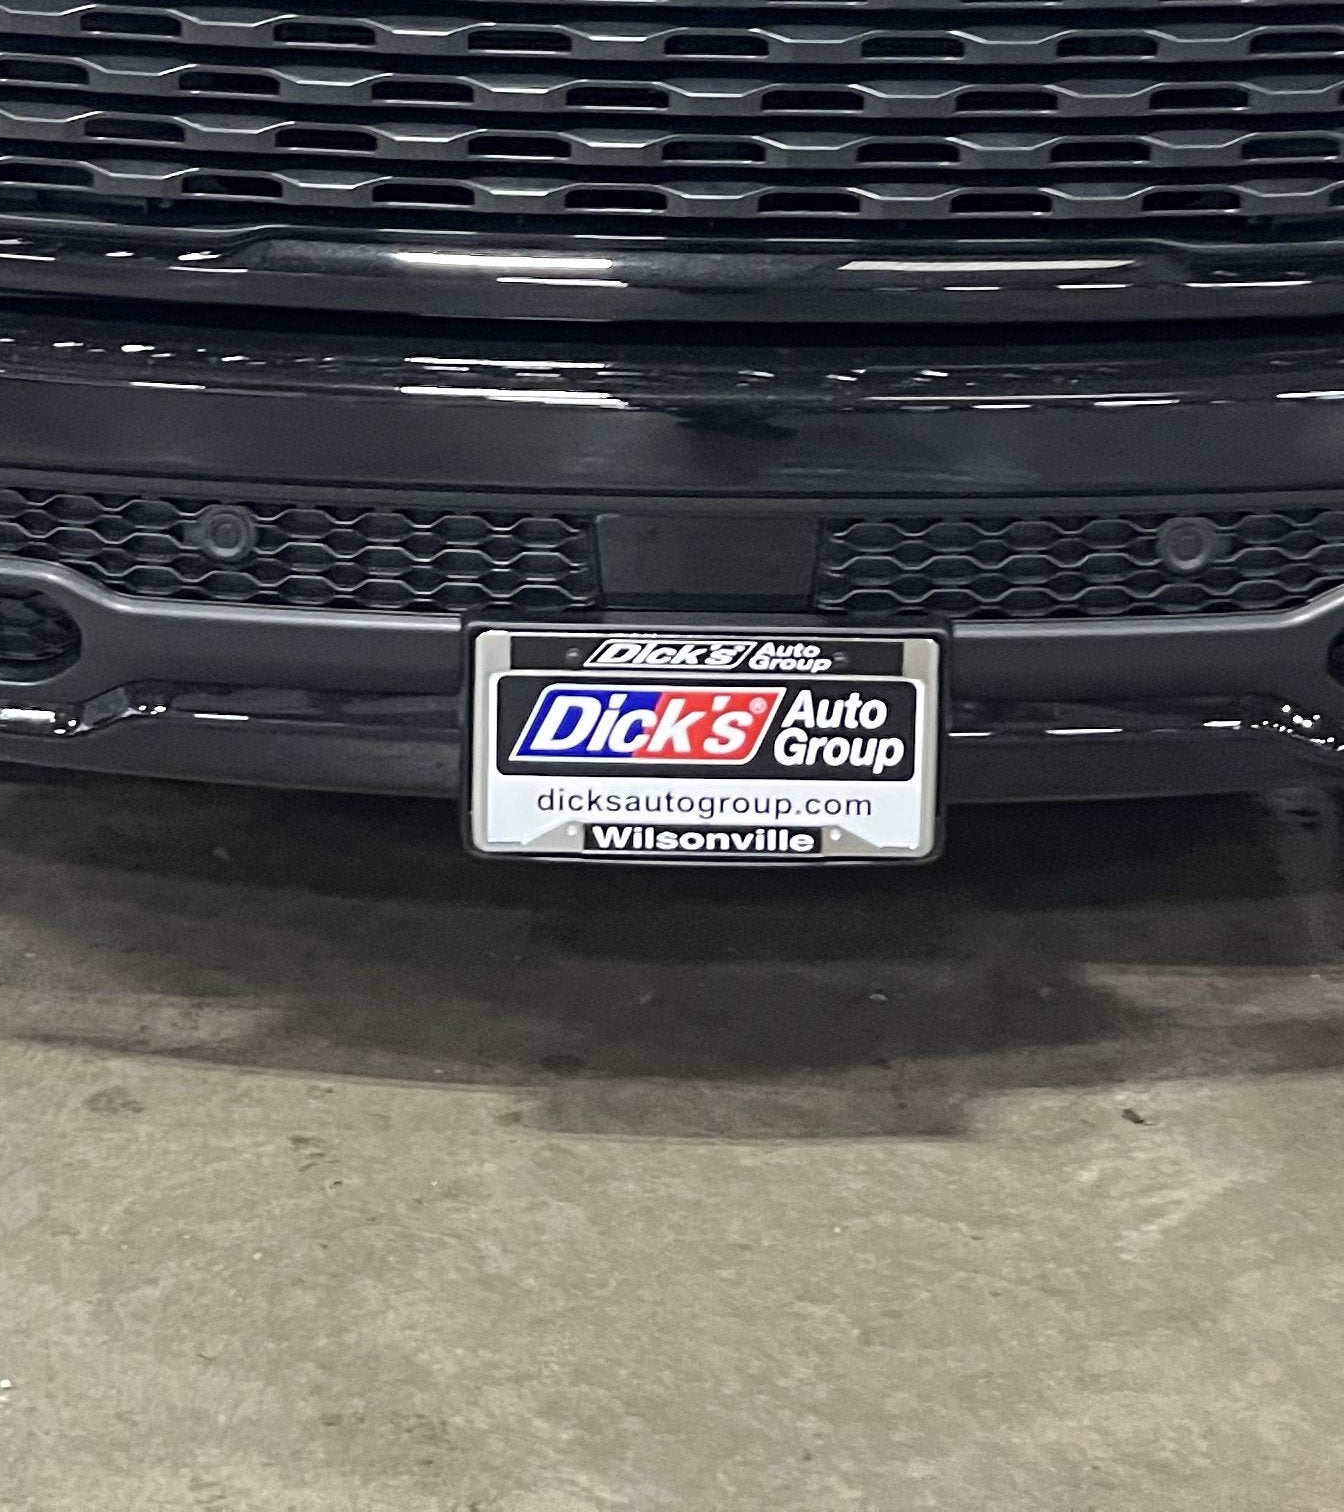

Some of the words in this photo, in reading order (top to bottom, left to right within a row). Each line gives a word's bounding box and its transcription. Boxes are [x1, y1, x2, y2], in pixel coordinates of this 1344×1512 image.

[748, 656, 833, 674] Group
[755, 642, 822, 659] Auto
[780, 689, 889, 730] Auto
[773, 729, 906, 775] Group
[537, 788, 873, 819] dicksautogroup.com
[592, 825, 816, 853] Wilsonville
